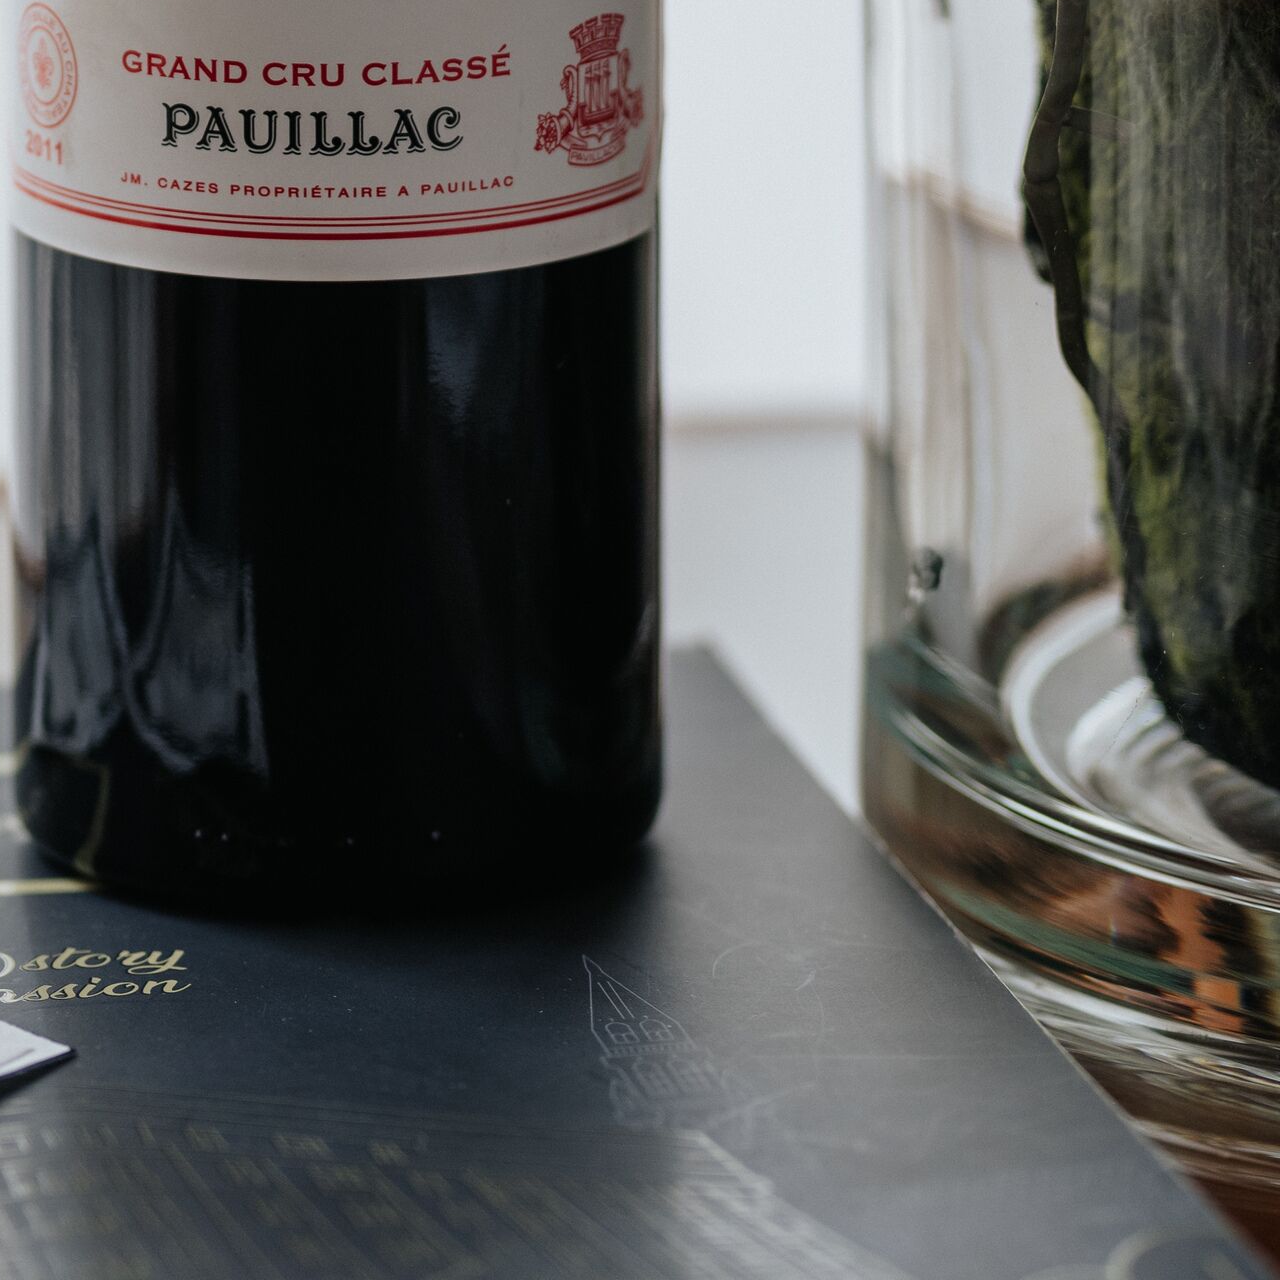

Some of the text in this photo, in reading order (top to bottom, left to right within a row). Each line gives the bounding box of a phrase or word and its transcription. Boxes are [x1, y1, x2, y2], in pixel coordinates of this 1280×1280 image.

[121, 42, 512, 87] GRAND CRU CLASSÉ
[25, 128, 64, 165] 2011
[161, 101, 464, 157] PAUILLAC
[120, 171, 515, 199] JM. CAZES PROPRIÉTAIRE A PAUILLAC
